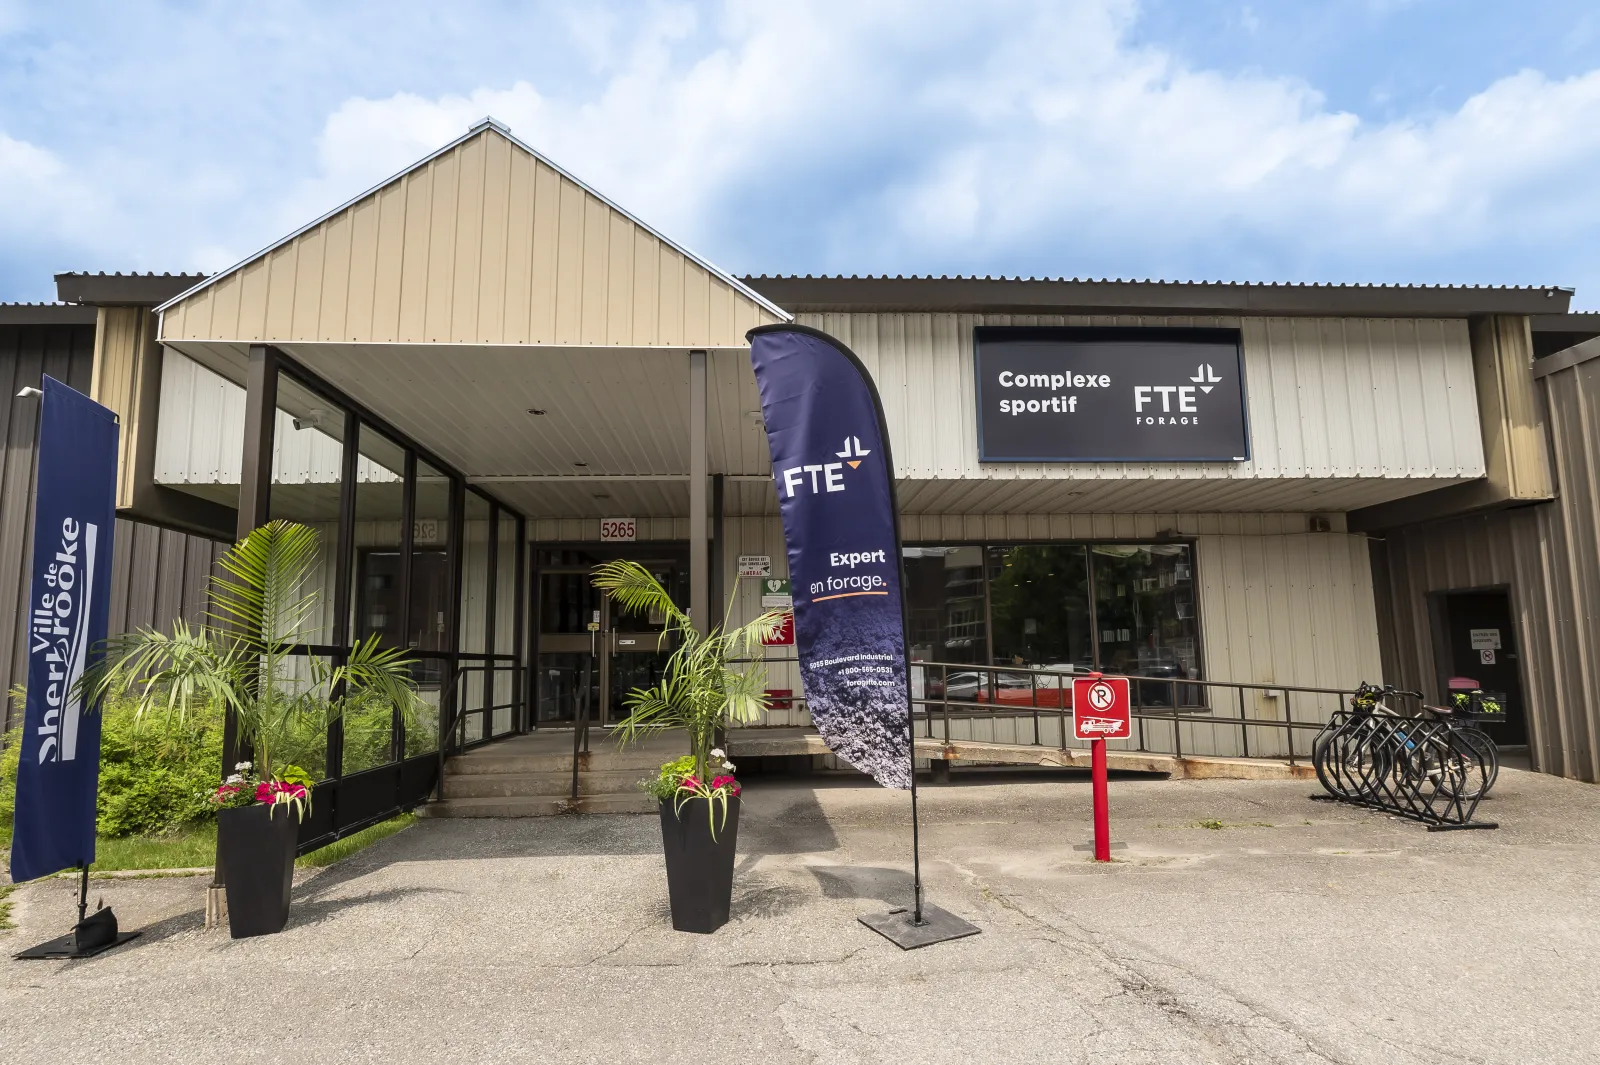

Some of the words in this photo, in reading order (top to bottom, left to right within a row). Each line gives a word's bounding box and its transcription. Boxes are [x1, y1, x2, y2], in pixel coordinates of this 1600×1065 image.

[998, 370, 1111, 391] Complexe
[999, 395, 1078, 416] sportif
[1133, 385, 1198, 413] FTE
[1136, 416, 1199, 425] FORAGE
[783, 462, 845, 498] FTE
[601, 521, 635, 538] 5265
[830, 549, 886, 569] Expert
[810, 581, 824, 594] en
[827, 575, 887, 591] forage.
[31, 593, 55, 654] Ville
[43, 563, 58, 588] de
[38, 517, 80, 766] Sherbrooke
[824, 654, 860, 666] Boulevard
[860, 653, 893, 661] Industriel
